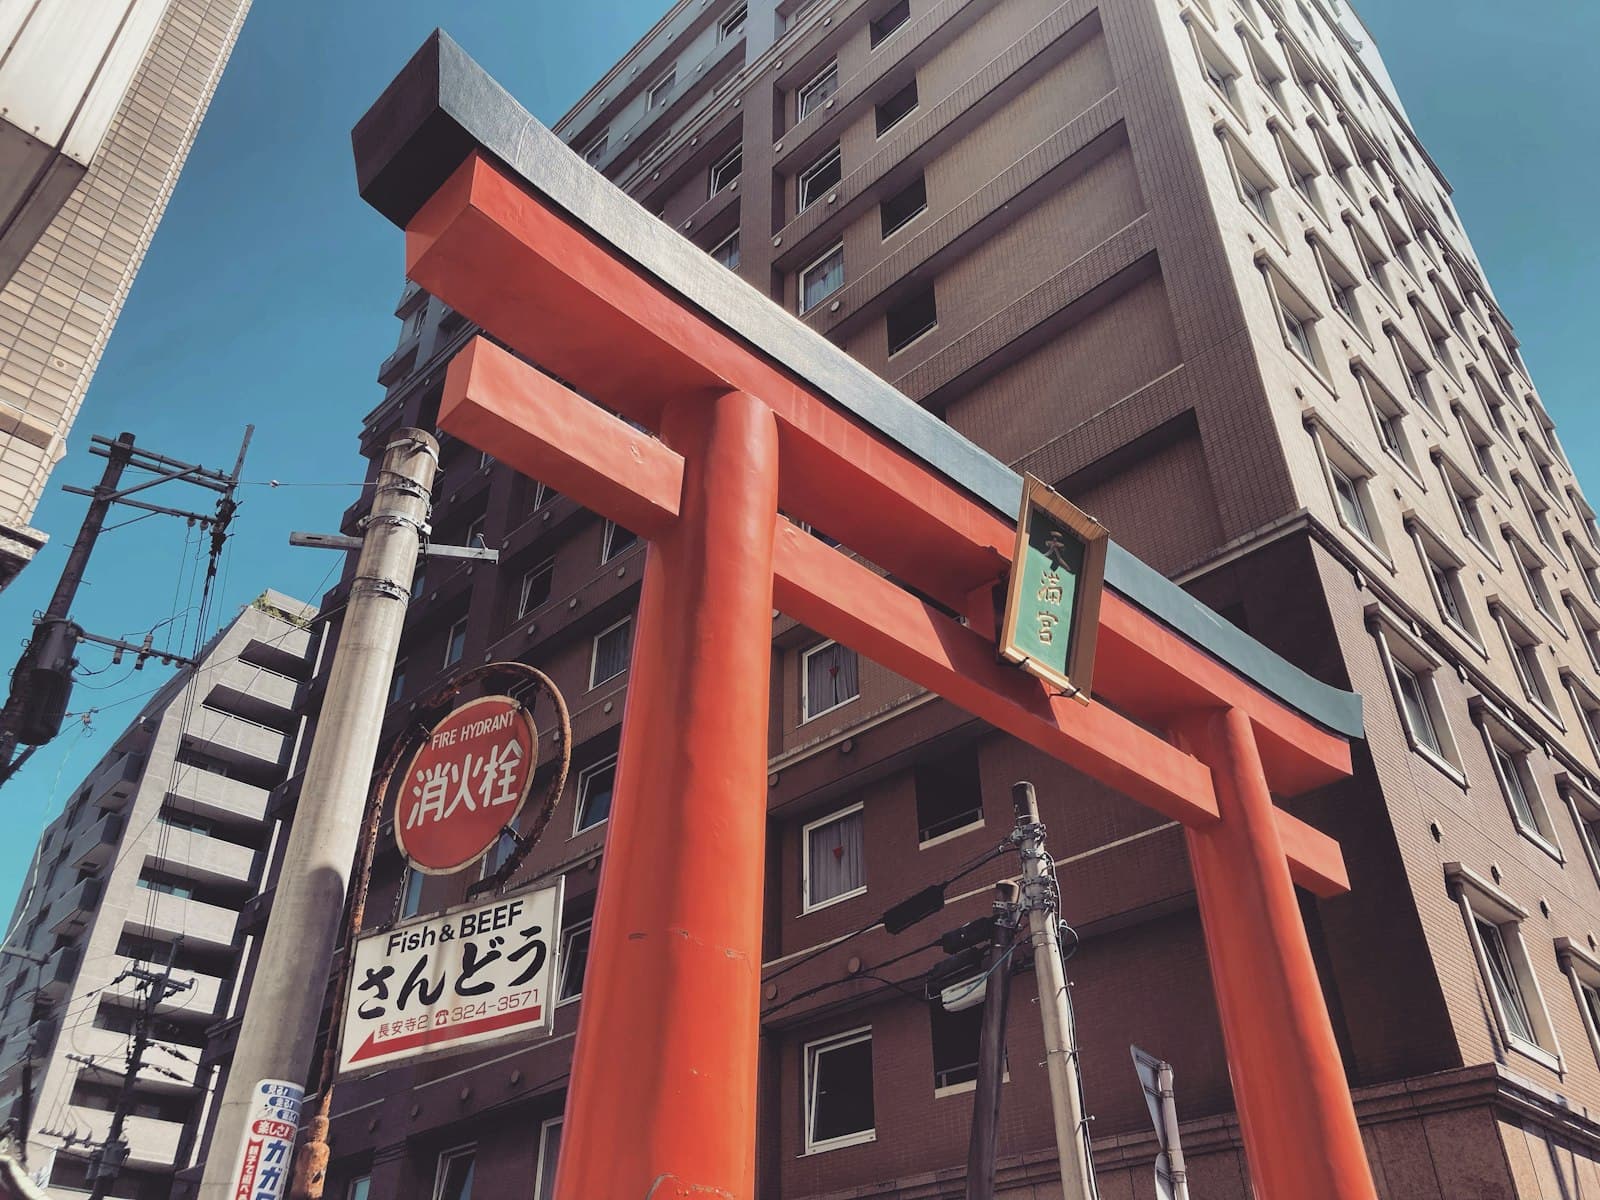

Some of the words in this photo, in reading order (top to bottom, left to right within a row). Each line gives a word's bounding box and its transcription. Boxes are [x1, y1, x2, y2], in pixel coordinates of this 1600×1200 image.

[431, 728, 457, 751] FIRE
[460, 710, 517, 742] HYDRANT
[406, 739, 524, 830] 消火栓
[357, 925, 547, 1020] さんどう
[451, 988, 539, 1022] 324-3571
